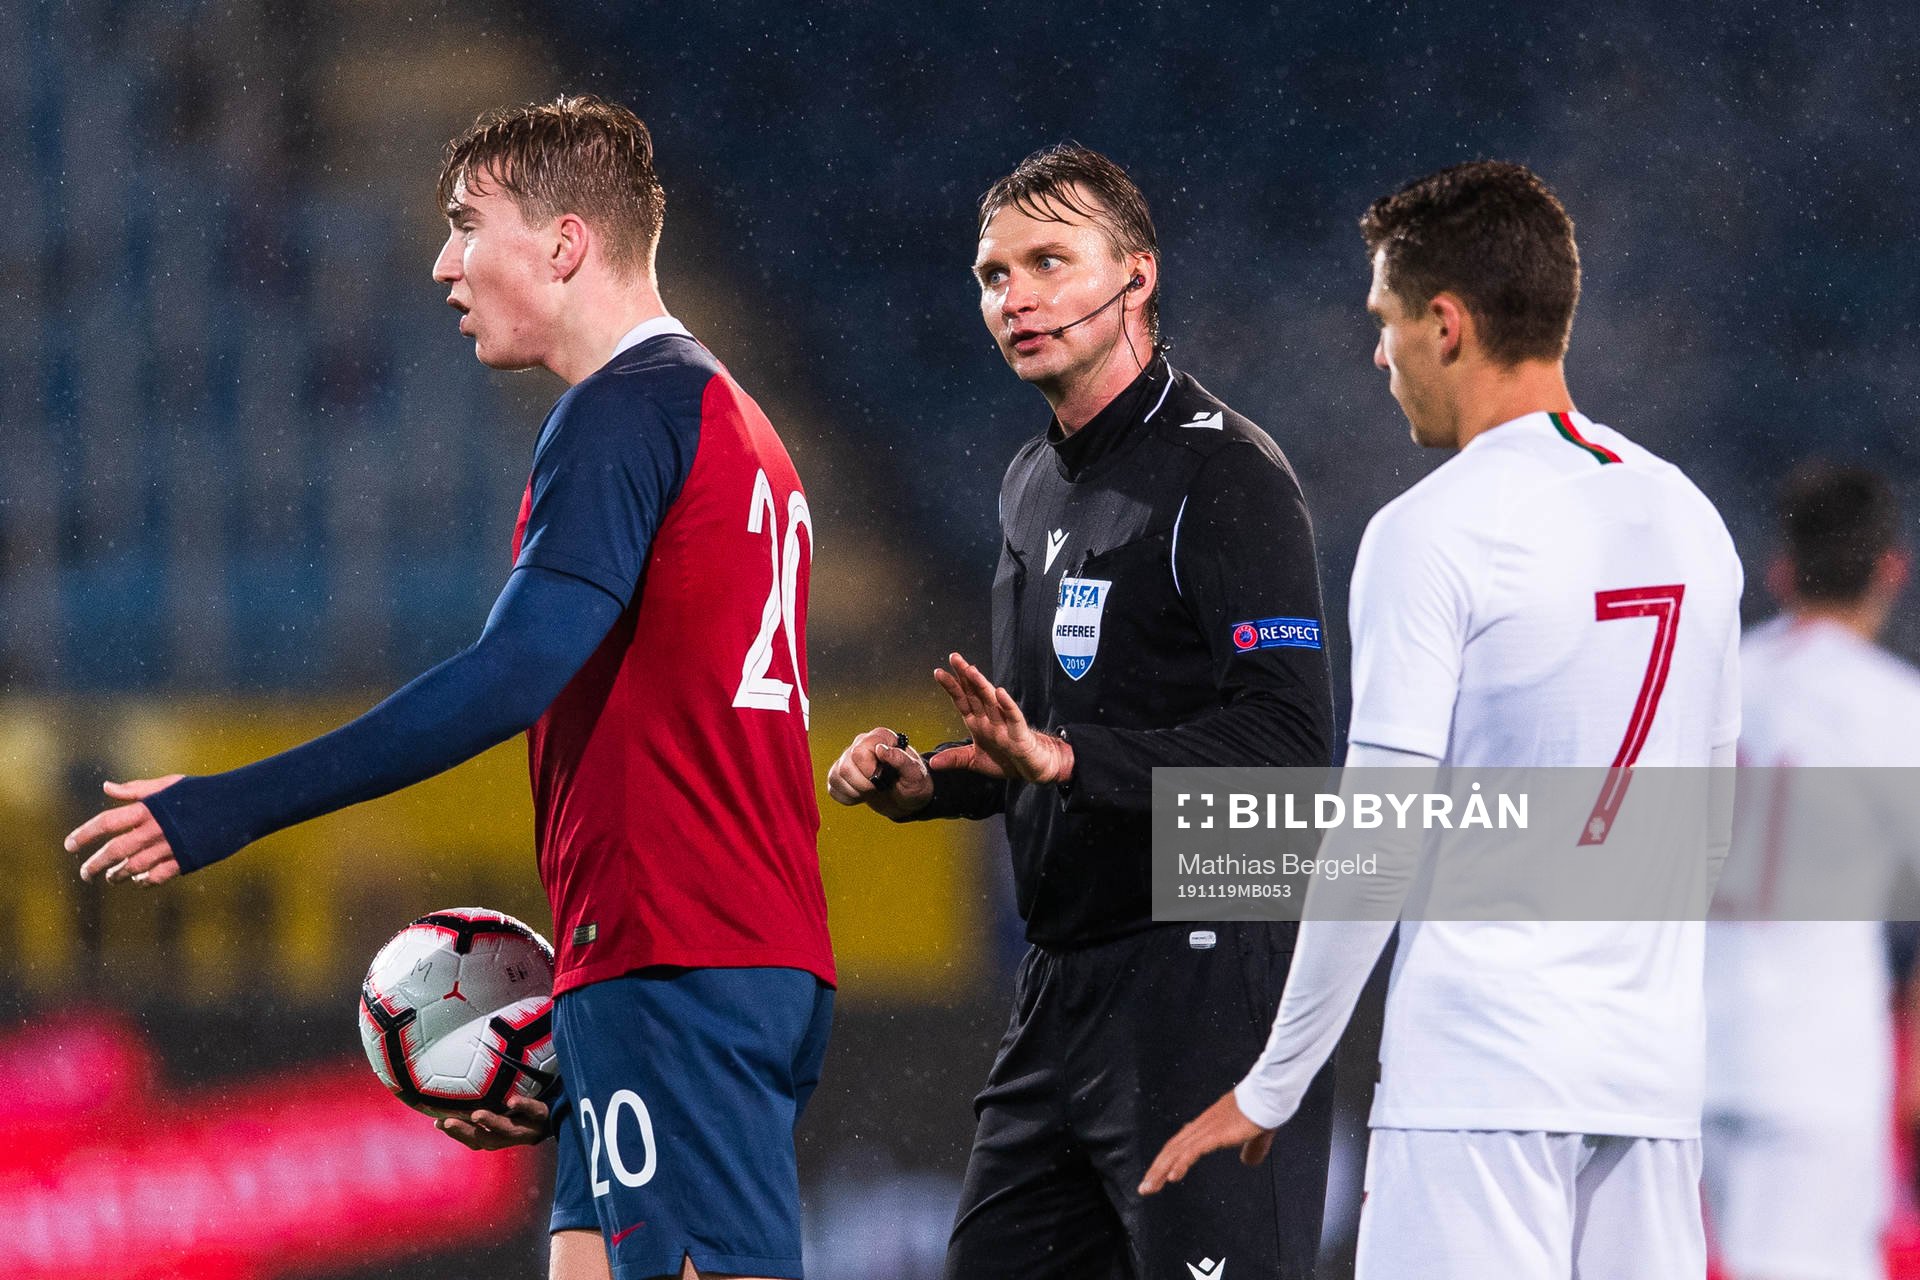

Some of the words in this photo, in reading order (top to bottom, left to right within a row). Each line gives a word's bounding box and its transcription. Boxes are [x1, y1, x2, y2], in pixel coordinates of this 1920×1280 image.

[732, 468, 813, 731] 20
[1060, 584, 1100, 609] FIFA
[1056, 625, 1096, 638] REFEREE
[1259, 625, 1319, 641] RESPECT
[1066, 658, 1086, 670] 2019
[1576, 584, 1685, 846] 7
[579, 1089, 657, 1198] 20
